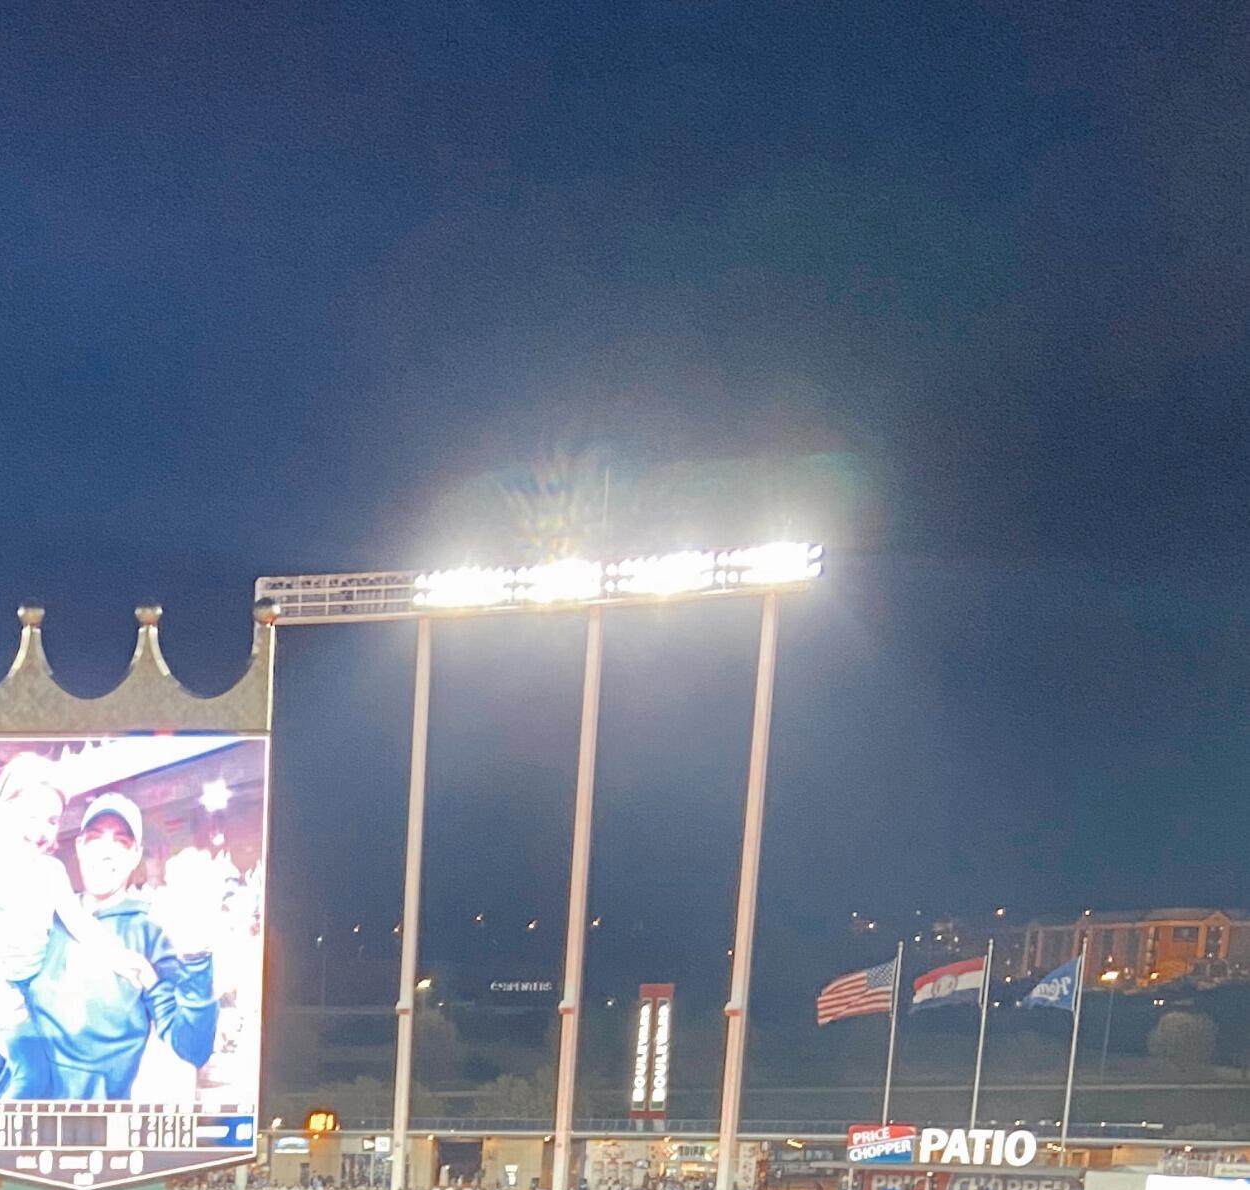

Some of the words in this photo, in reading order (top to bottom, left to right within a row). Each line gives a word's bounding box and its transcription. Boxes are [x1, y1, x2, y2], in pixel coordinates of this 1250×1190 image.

[852, 1126, 891, 1145] PRICE
[849, 1139, 912, 1162] CHOPPER
[920, 1128, 1037, 1167] PATIO
